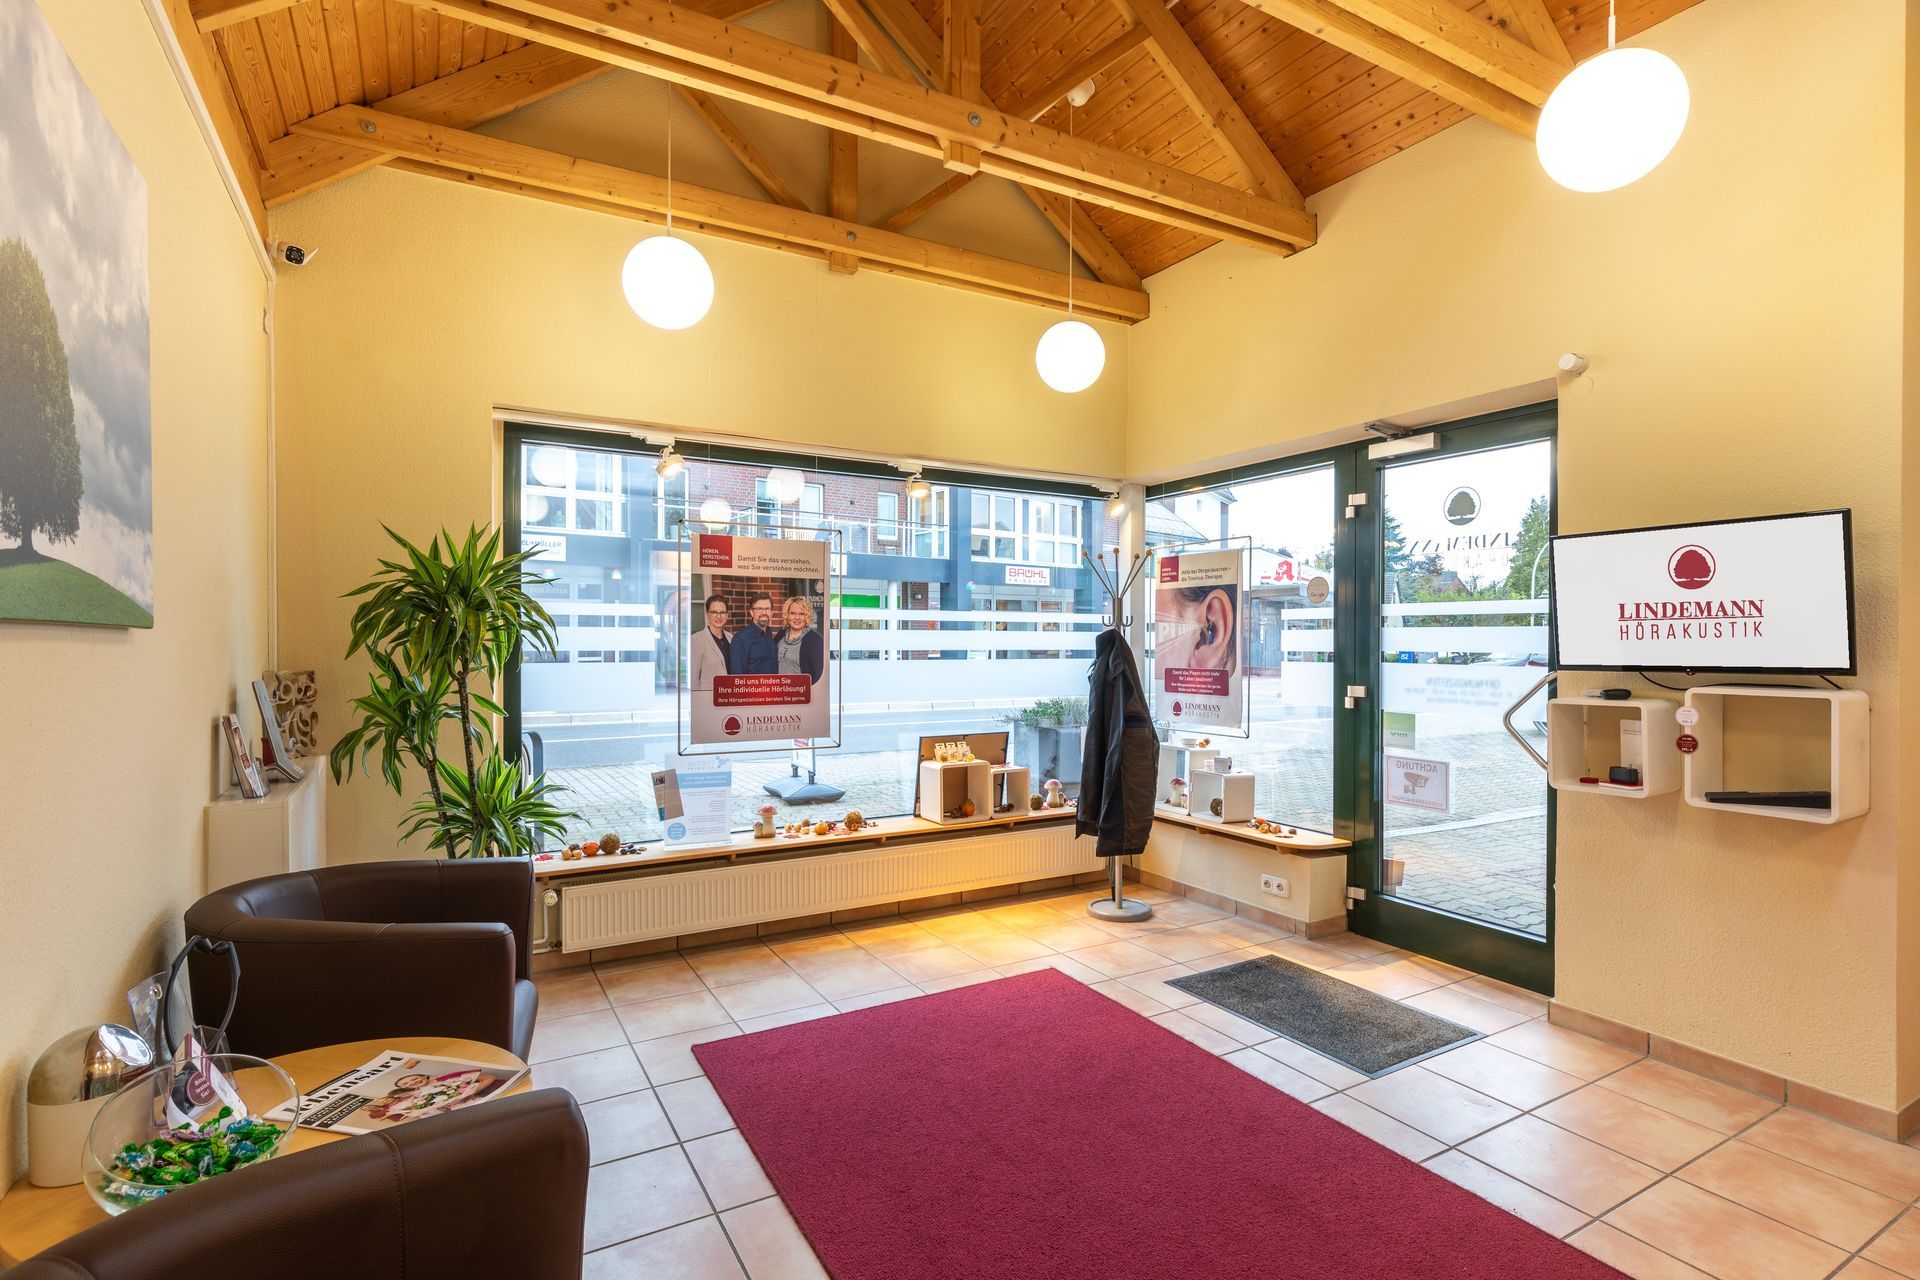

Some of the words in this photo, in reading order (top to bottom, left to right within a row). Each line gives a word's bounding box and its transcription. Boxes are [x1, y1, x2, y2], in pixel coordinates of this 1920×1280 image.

[737, 555, 756, 563] Damit
[757, 555, 767, 563] Sie
[780, 557, 812, 566] verstehen,
[762, 564, 792, 572] verstehen
[793, 566, 821, 574] möchten.
[1617, 599, 1765, 620] LINDEMANN
[1619, 620, 1763, 641] HÖRAKUSTIK
[781, 677, 792, 685] Sie
[718, 686, 732, 694] Ihre
[733, 686, 771, 694] individuelle
[772, 685, 806, 694] Hörlösung!
[1184, 702, 1221, 712] LINDEMANN
[746, 715, 802, 725] LINDEMANN
[746, 723, 801, 733] HÖRAKUSTIK
[282, 1056, 404, 1116] lebensart
